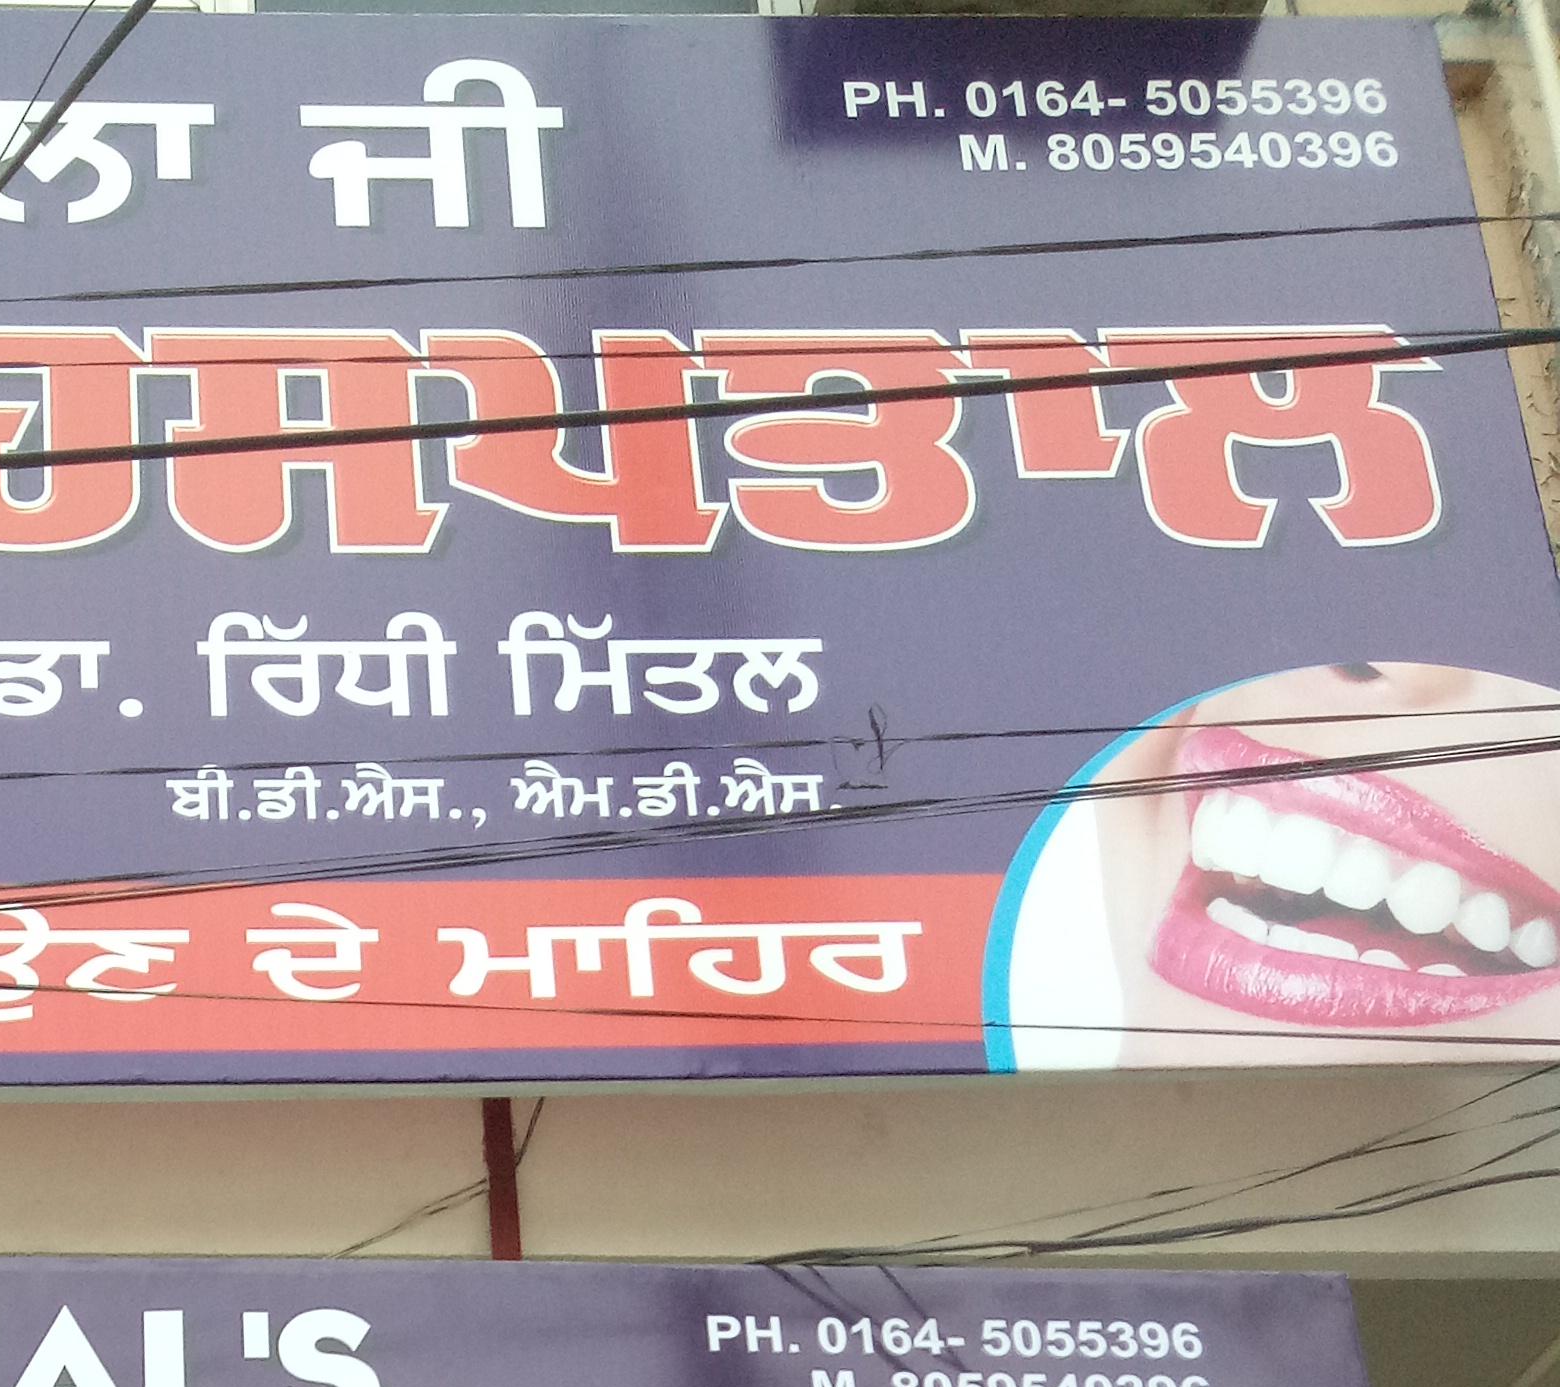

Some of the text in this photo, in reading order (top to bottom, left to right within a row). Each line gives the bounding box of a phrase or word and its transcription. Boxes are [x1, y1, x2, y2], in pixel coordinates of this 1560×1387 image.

[844, 78, 1387, 117] PH. 0164- 5055396
[300, 58, 563, 228] ਜੀ
[959, 131, 1398, 170] M. 8059540396
[197, 612, 457, 716] ਰਿੱਧੀ
[498, 611, 822, 715] ਮਿੱਤਲ
[245, 903, 378, 1000] ਦੇ
[438, 897, 922, 997] ਮਾਹਿਰ
[707, 1316, 1202, 1358] PH. 0164- 5055396
